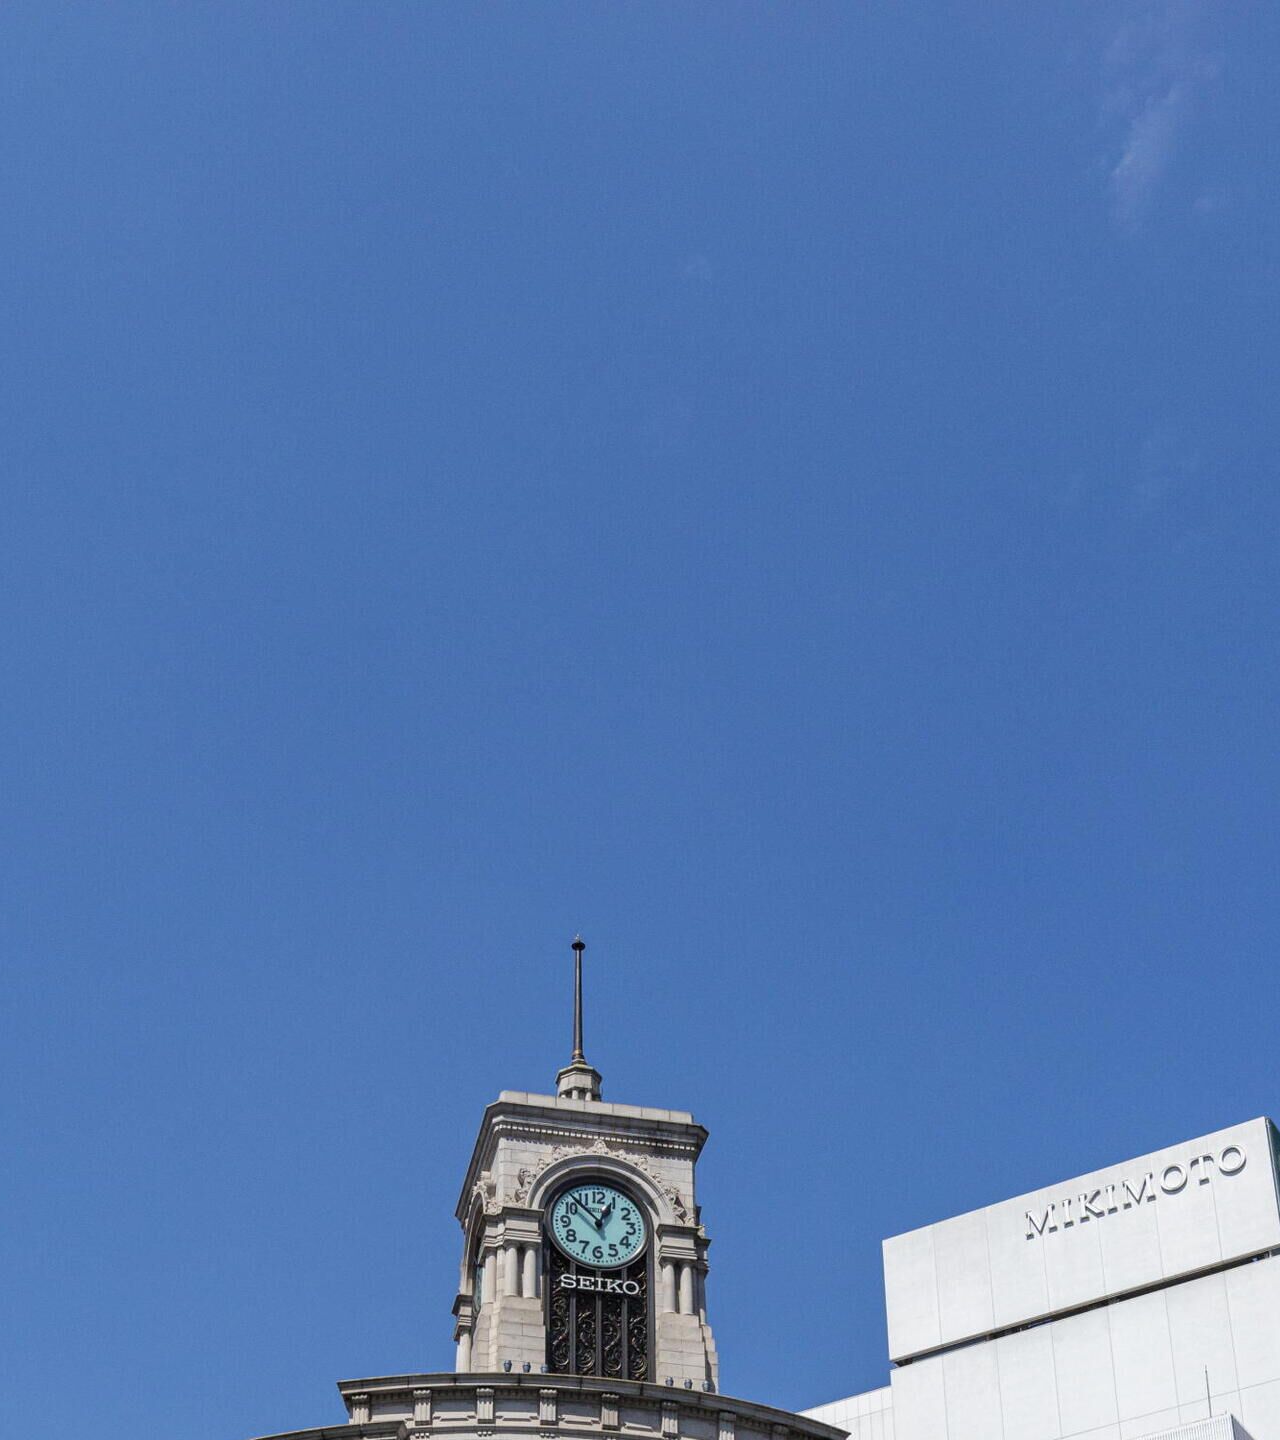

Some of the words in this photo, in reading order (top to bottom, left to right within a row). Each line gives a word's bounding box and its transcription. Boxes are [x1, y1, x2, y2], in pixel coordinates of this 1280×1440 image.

[591, 1191, 606, 1205] 12
[1025, 1144, 1247, 1240] MIKIMOTO
[564, 1201, 578, 1216] 10
[620, 1207, 631, 1221] 2
[559, 1214, 571, 1228] 9
[565, 1228, 577, 1243] 8
[626, 1222, 637, 1236] 3
[578, 1240, 590, 1254] 7
[620, 1235, 632, 1249] 4
[592, 1246, 604, 1260] 6
[607, 1244, 619, 1258] 5
[560, 1274, 640, 1295] SEIKO
